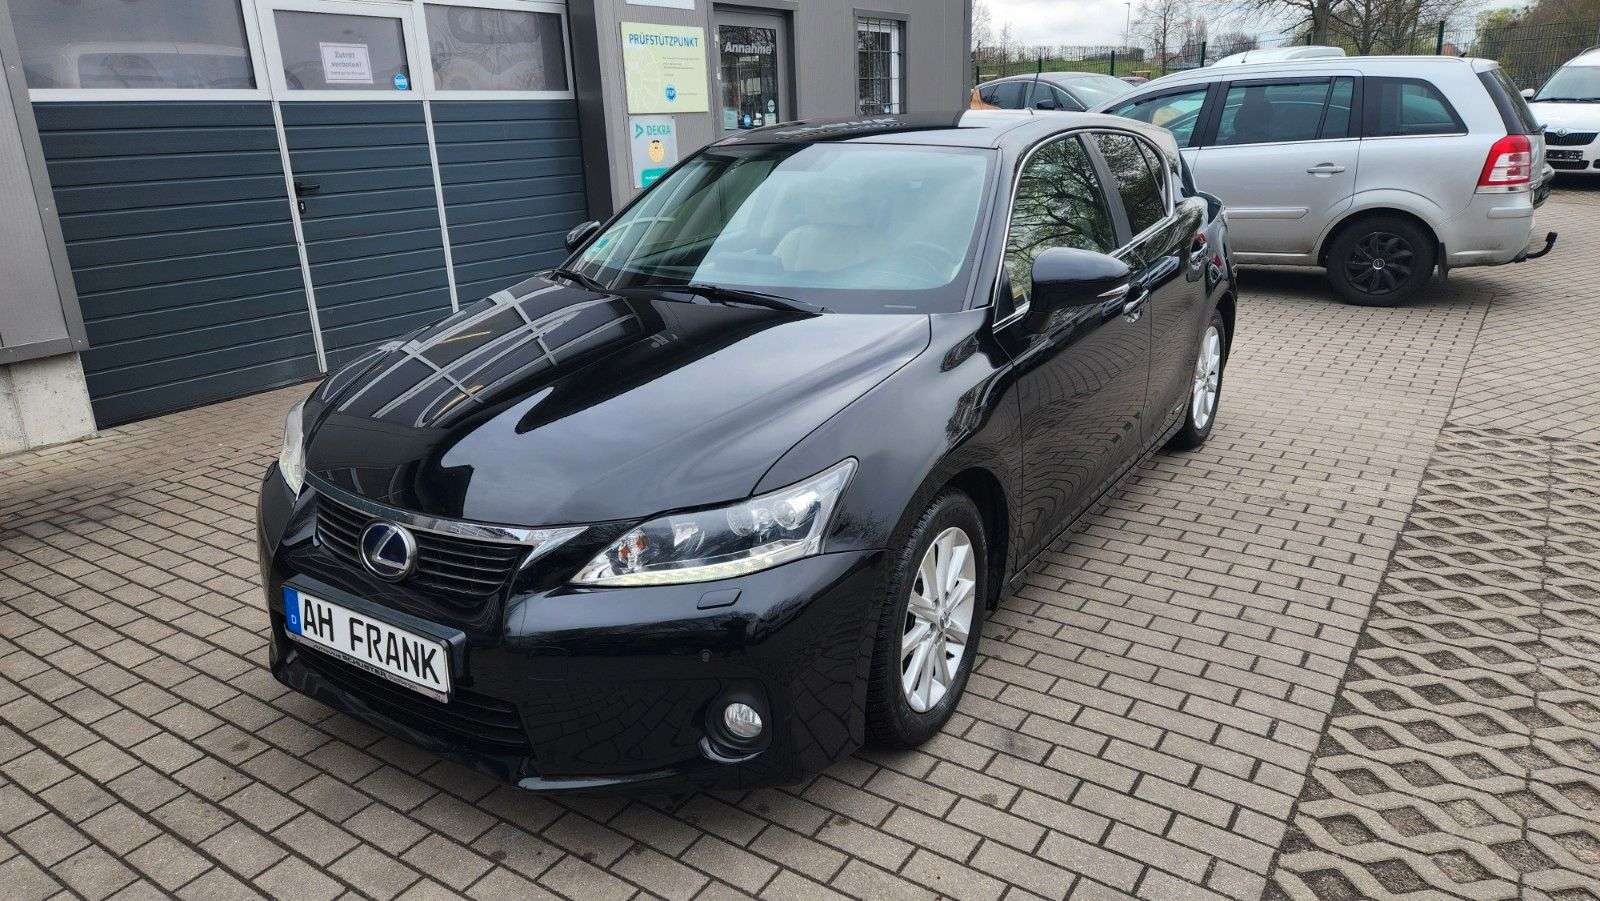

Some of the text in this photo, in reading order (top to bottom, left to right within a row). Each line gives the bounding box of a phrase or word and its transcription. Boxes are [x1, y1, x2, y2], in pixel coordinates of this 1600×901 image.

[724, 41, 772, 55] Annahme
[646, 125, 672, 136] DEKRA
[290, 614, 297, 625] D
[303, 599, 441, 685] AH FRANK
